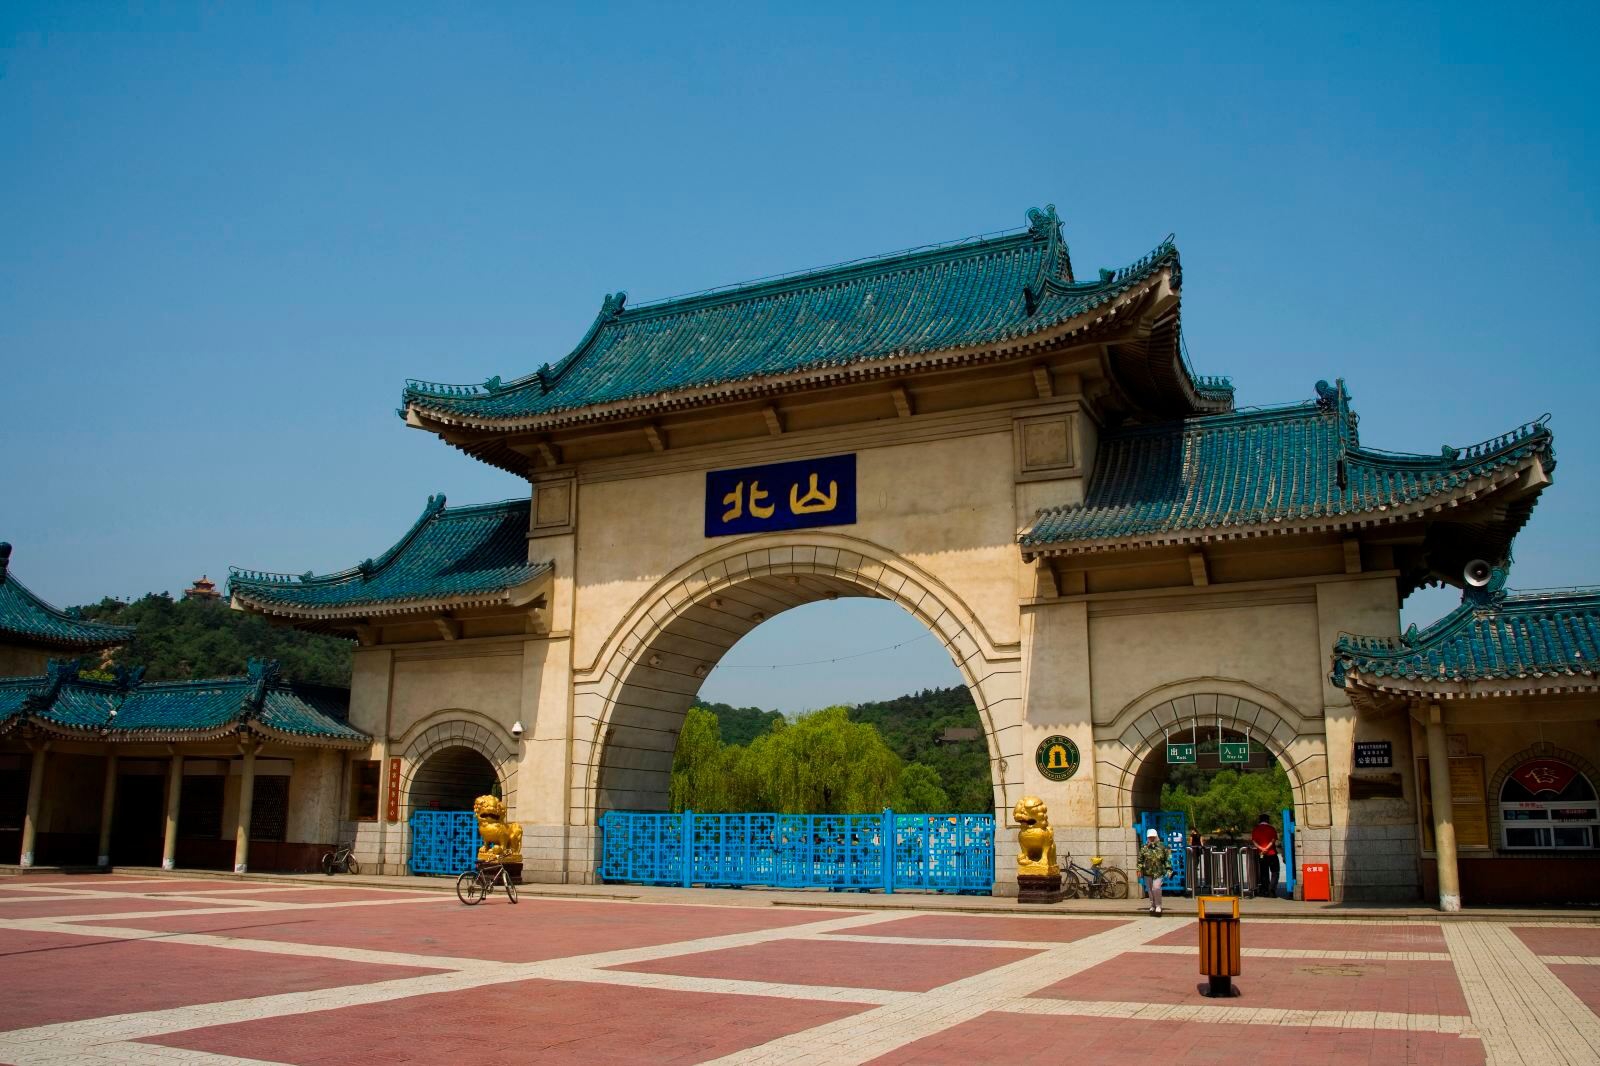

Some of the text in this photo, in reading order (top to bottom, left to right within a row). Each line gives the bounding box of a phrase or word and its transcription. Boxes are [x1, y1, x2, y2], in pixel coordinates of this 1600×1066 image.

[722, 473, 837, 522] 北山
[1170, 747, 1192, 756] 出口
[1223, 747, 1246, 755] 入口
